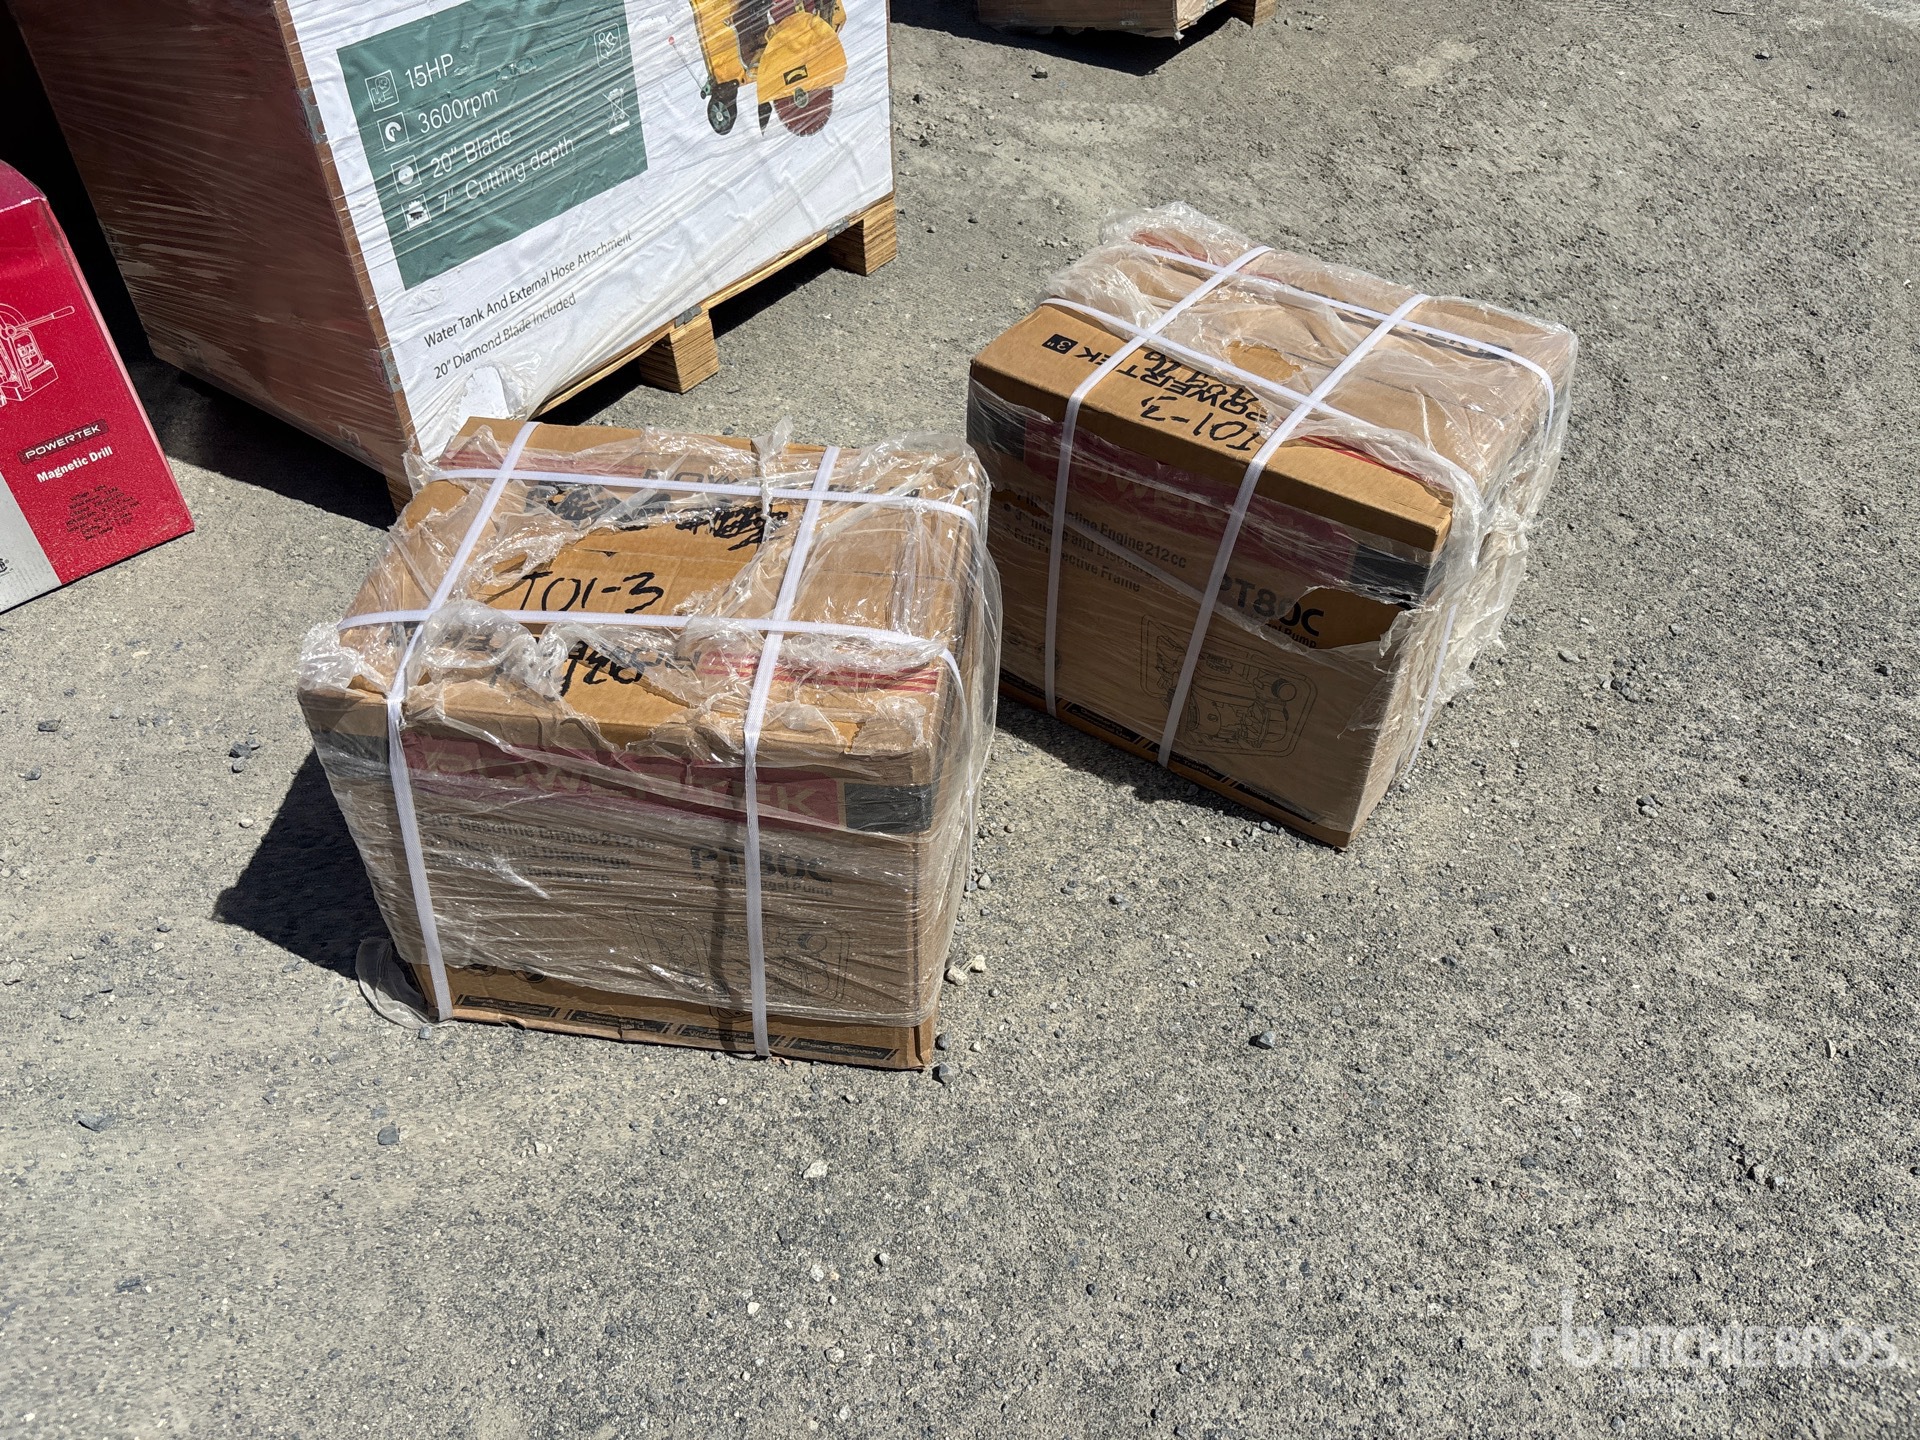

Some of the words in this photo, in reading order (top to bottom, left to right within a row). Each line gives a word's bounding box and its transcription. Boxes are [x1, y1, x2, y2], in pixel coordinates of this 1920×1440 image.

[405, 53, 454, 90] 15HP
[418, 89, 499, 134] 3600rpm
[430, 147, 457, 178] 20"
[463, 130, 512, 164] Blade
[465, 162, 526, 200] Cutting
[530, 136, 575, 171] depth
[424, 324, 458, 348] Water
[458, 308, 485, 331] Tank
[486, 294, 508, 317] And
[509, 272, 550, 305] External
[550, 260, 576, 282] Hose
[577, 230, 633, 268] Attachment
[433, 358, 452, 380] 20"
[453, 333, 502, 369] Diamond
[502, 320, 532, 341] Blade
[532, 292, 577, 325] Included
[25, 424, 102, 459] POWERTEK
[36, 457, 89, 483] Magnetic
[89, 445, 113, 462] Drill
[1099, 522, 1142, 552] Engine
[1100, 563, 1142, 592] Frame
[800, 1041, 830, 1050] Flood
[831, 1045, 882, 1057] Recovery
